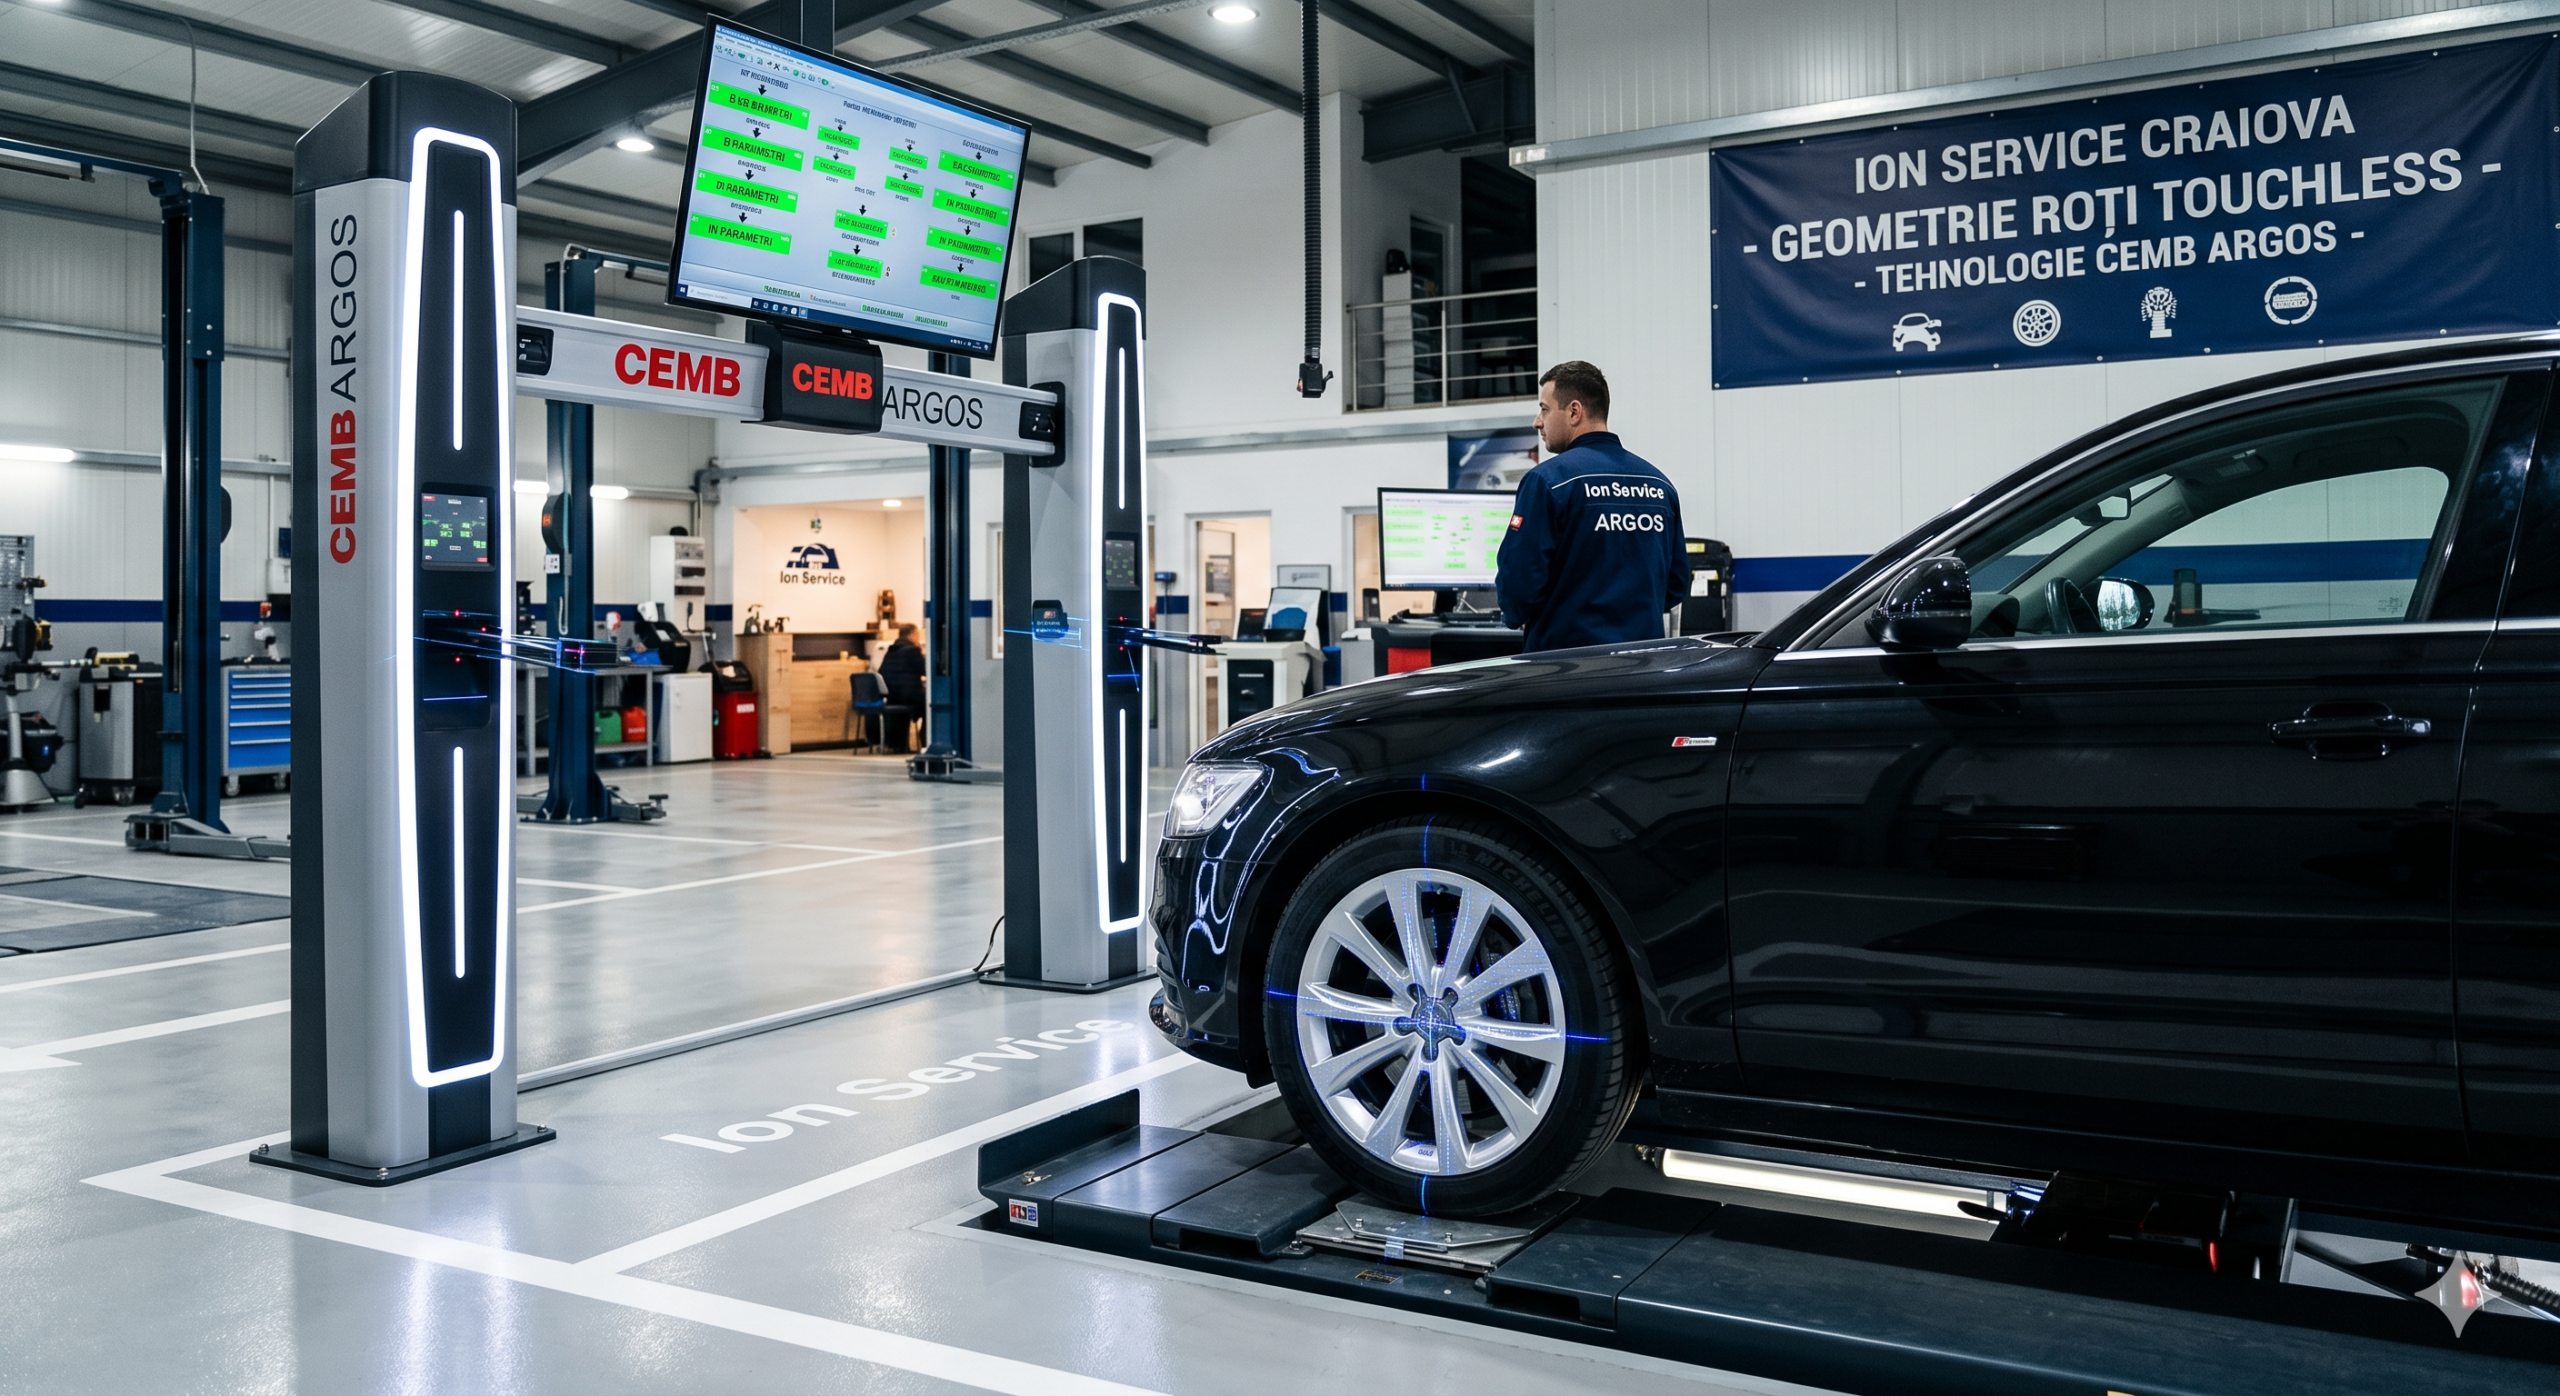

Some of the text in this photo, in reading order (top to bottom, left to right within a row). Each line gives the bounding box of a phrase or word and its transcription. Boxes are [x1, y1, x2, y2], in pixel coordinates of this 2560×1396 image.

[1854, 94, 2356, 194] ION SERVICE CRAIOVA
[1771, 199, 2018, 262] GEOMETRIE
[2032, 186, 2137, 239] ROȚI
[2153, 149, 2462, 221] TOUCHLESS
[708, 223, 774, 247] IN PARAMETRI
[1875, 246, 2086, 295] TEHNOLOGIE
[2096, 236, 2196, 274] CEMB
[2207, 221, 2337, 264] ARGOS
[330, 214, 358, 563] CEMB ARGOS
[614, 343, 742, 397] CEMB
[792, 362, 874, 400] CEMB
[881, 385, 984, 430] ARGOS
[1584, 482, 1664, 499] Ion Service
[1594, 513, 1664, 532] ARGOS
[780, 571, 846, 586] Ion Service
[658, 1018, 1135, 1154] Ion Service
